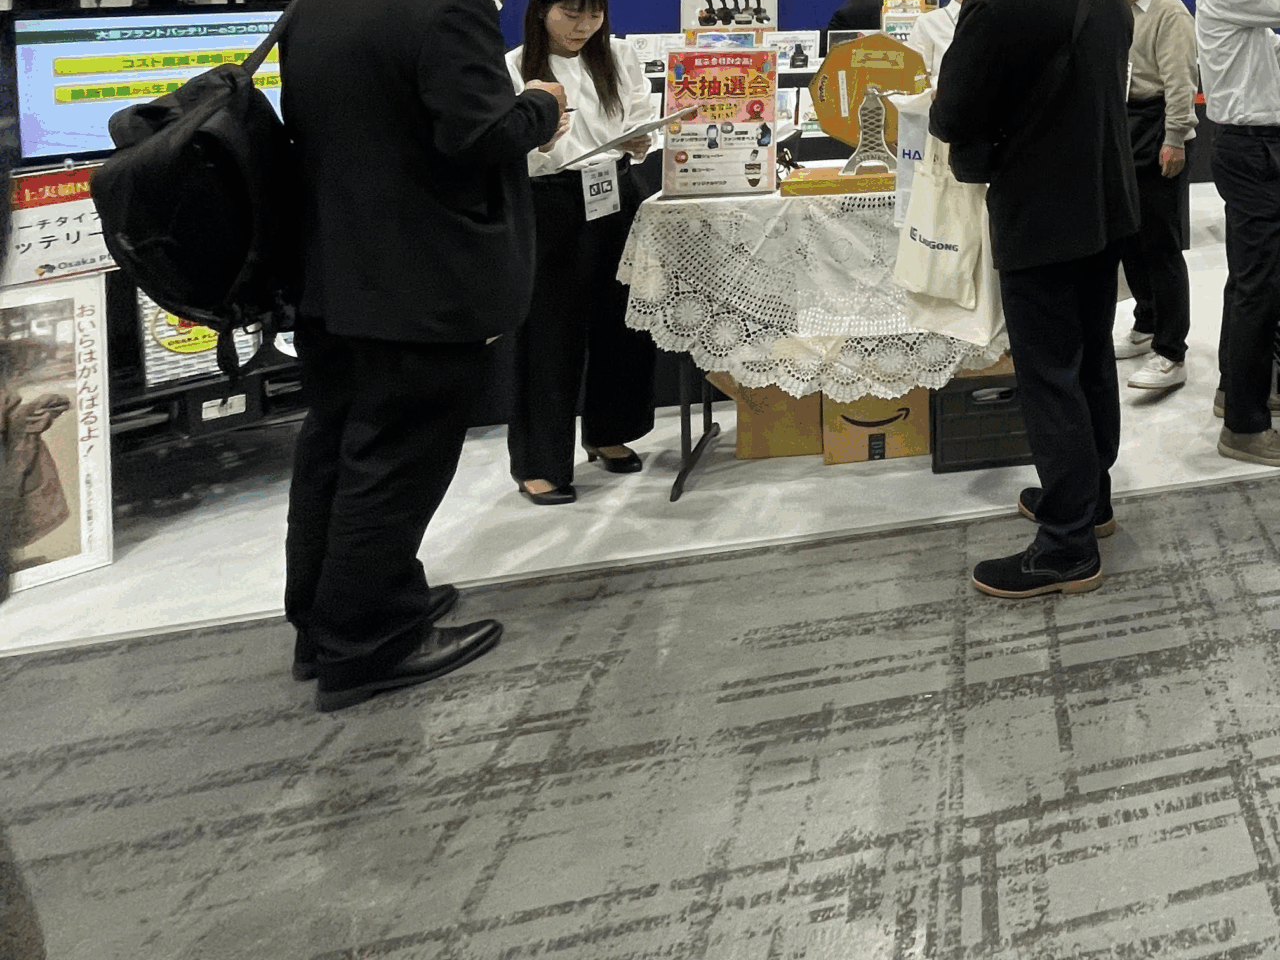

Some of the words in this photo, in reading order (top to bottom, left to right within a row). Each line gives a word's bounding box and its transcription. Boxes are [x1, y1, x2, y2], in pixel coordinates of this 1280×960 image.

[673, 74, 771, 98] 大抽選会
[58, 256, 97, 270] Osaka
